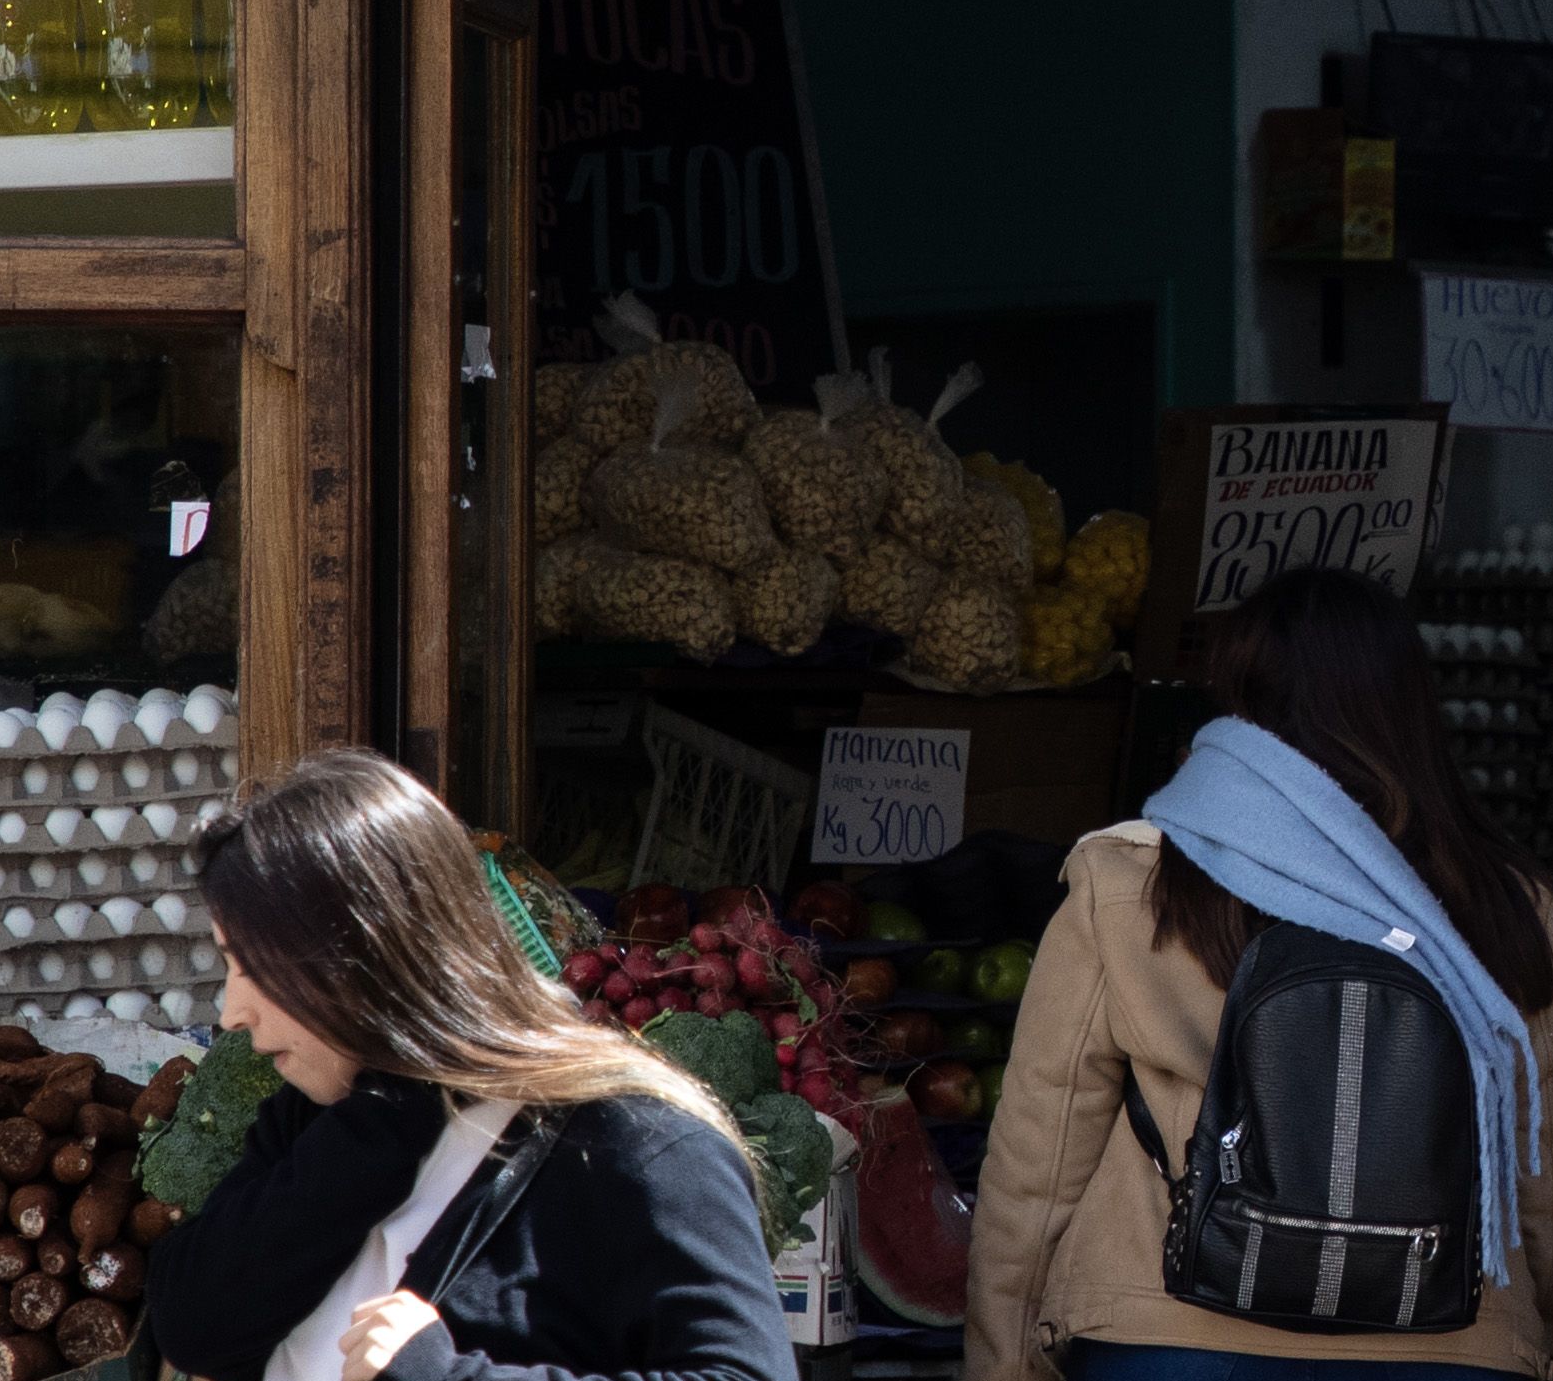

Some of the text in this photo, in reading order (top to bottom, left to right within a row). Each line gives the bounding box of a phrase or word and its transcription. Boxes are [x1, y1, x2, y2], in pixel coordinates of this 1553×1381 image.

[566, 143, 799, 294] 1500
[1215, 426, 1388, 478] BANANA
[1219, 472, 1379, 503] DE ECUADOR
[856, 796, 945, 859] 3000
